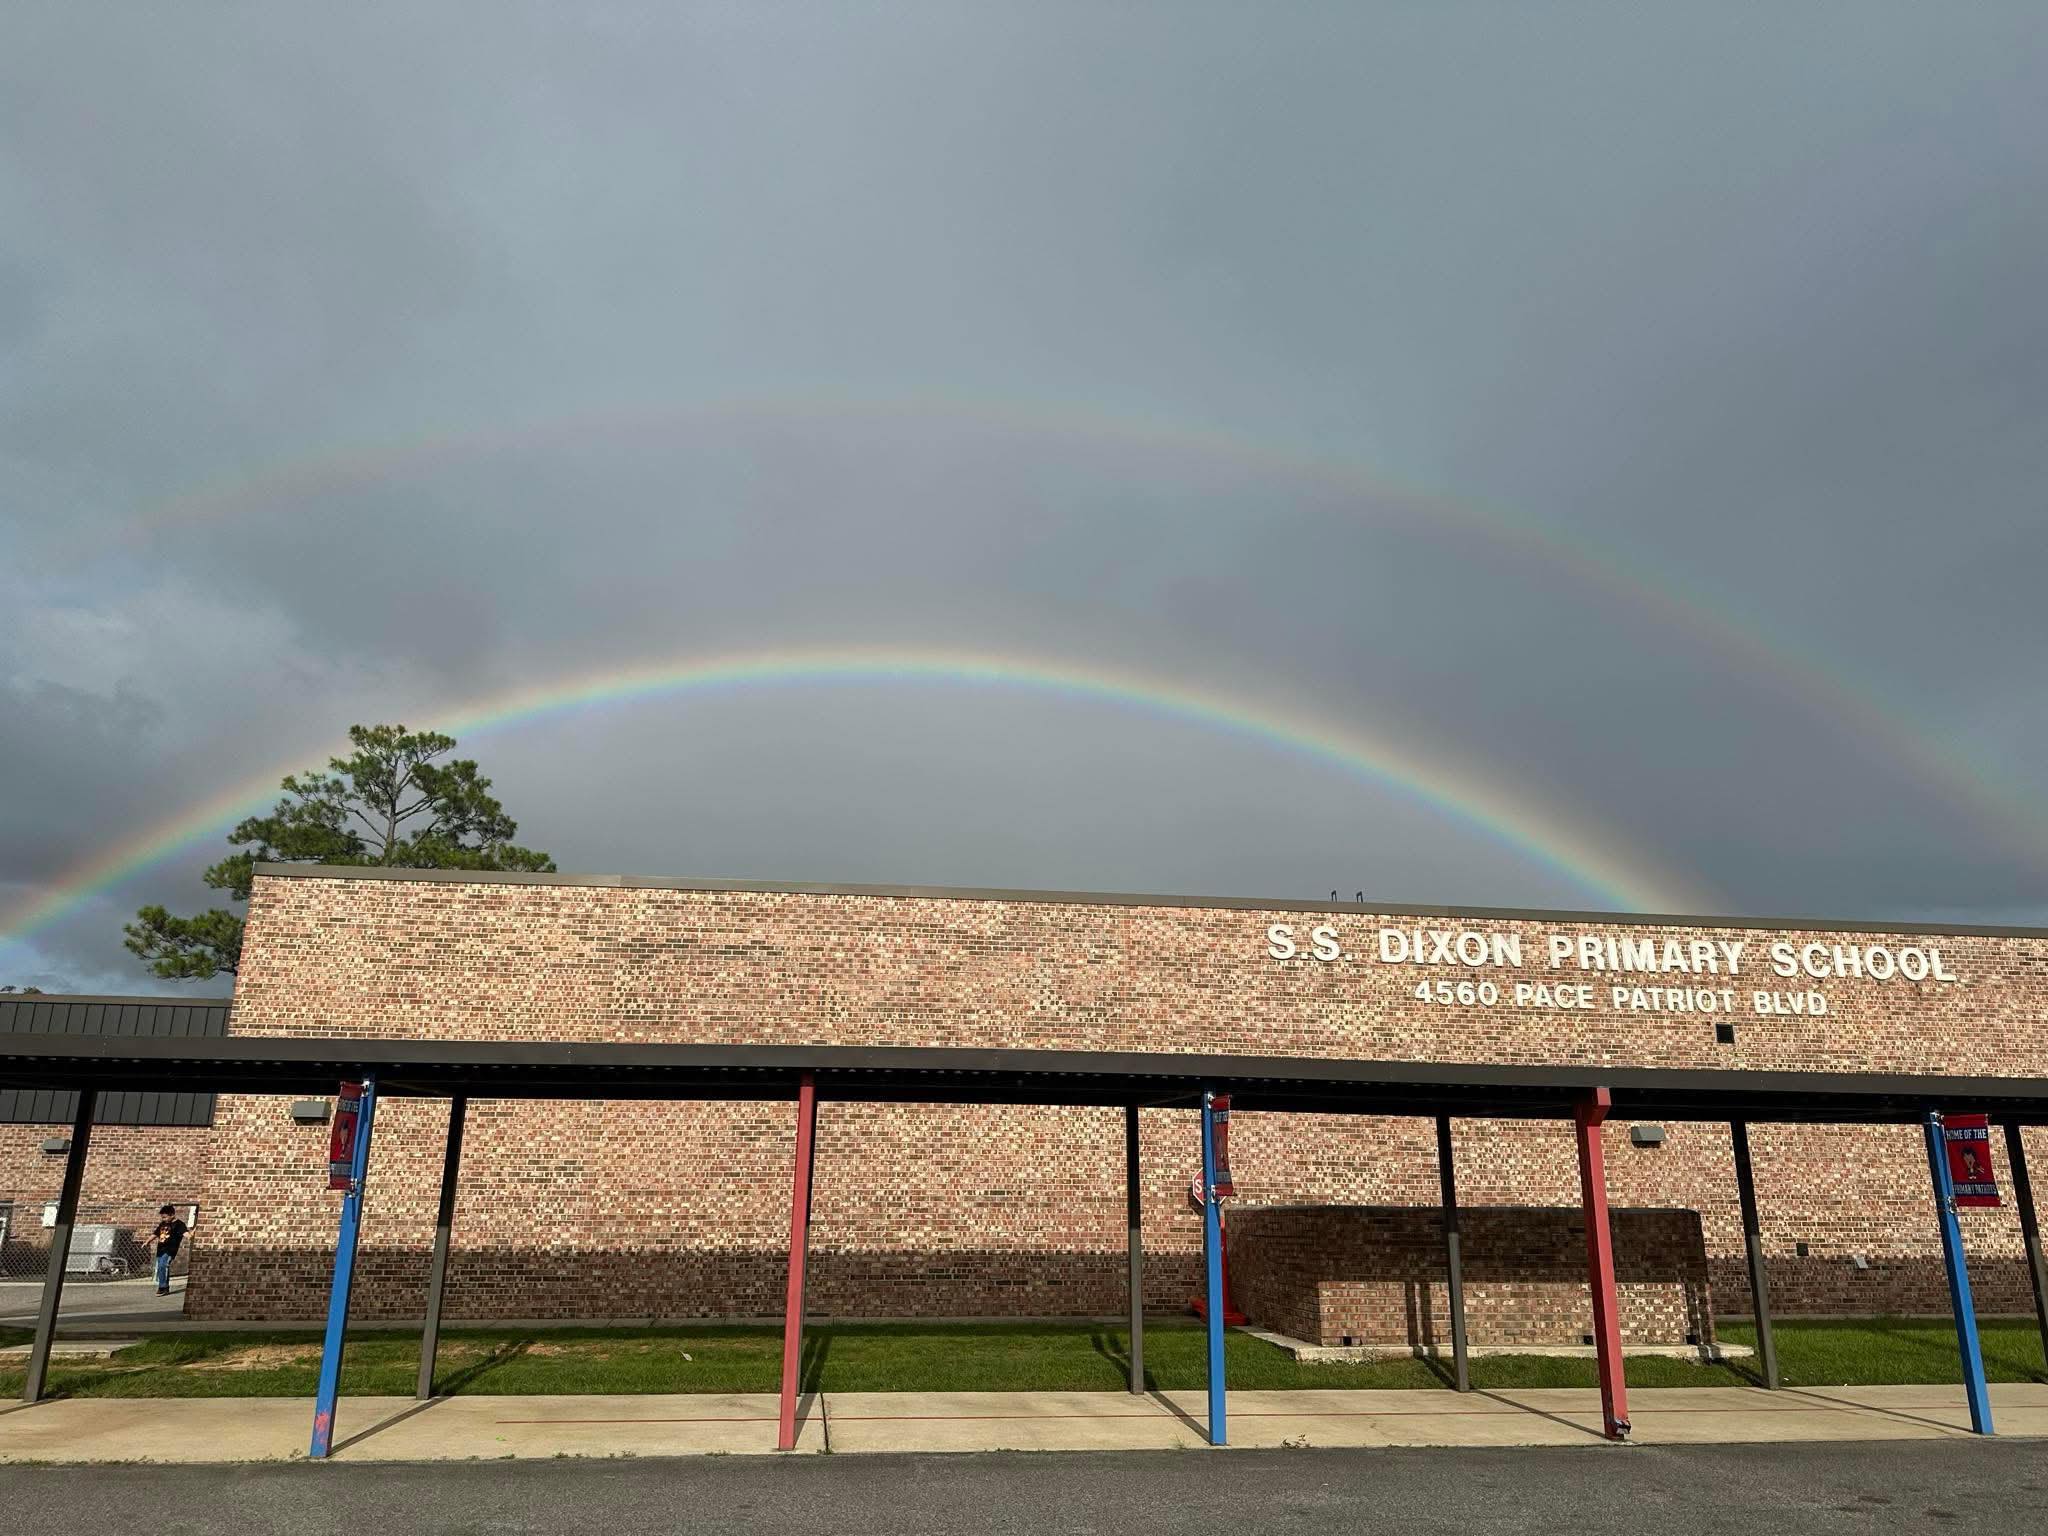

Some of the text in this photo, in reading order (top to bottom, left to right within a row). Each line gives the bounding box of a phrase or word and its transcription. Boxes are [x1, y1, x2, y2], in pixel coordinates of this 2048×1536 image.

[1267, 923, 1957, 982] S.S. DIXON PRIMARY SCHOOL
[1414, 979, 1499, 1006] 4560
[1515, 983, 1595, 1010] PACE
[1613, 986, 1735, 1014] PATRIOT
[1946, 1128, 1987, 1139] HOME OF THE
